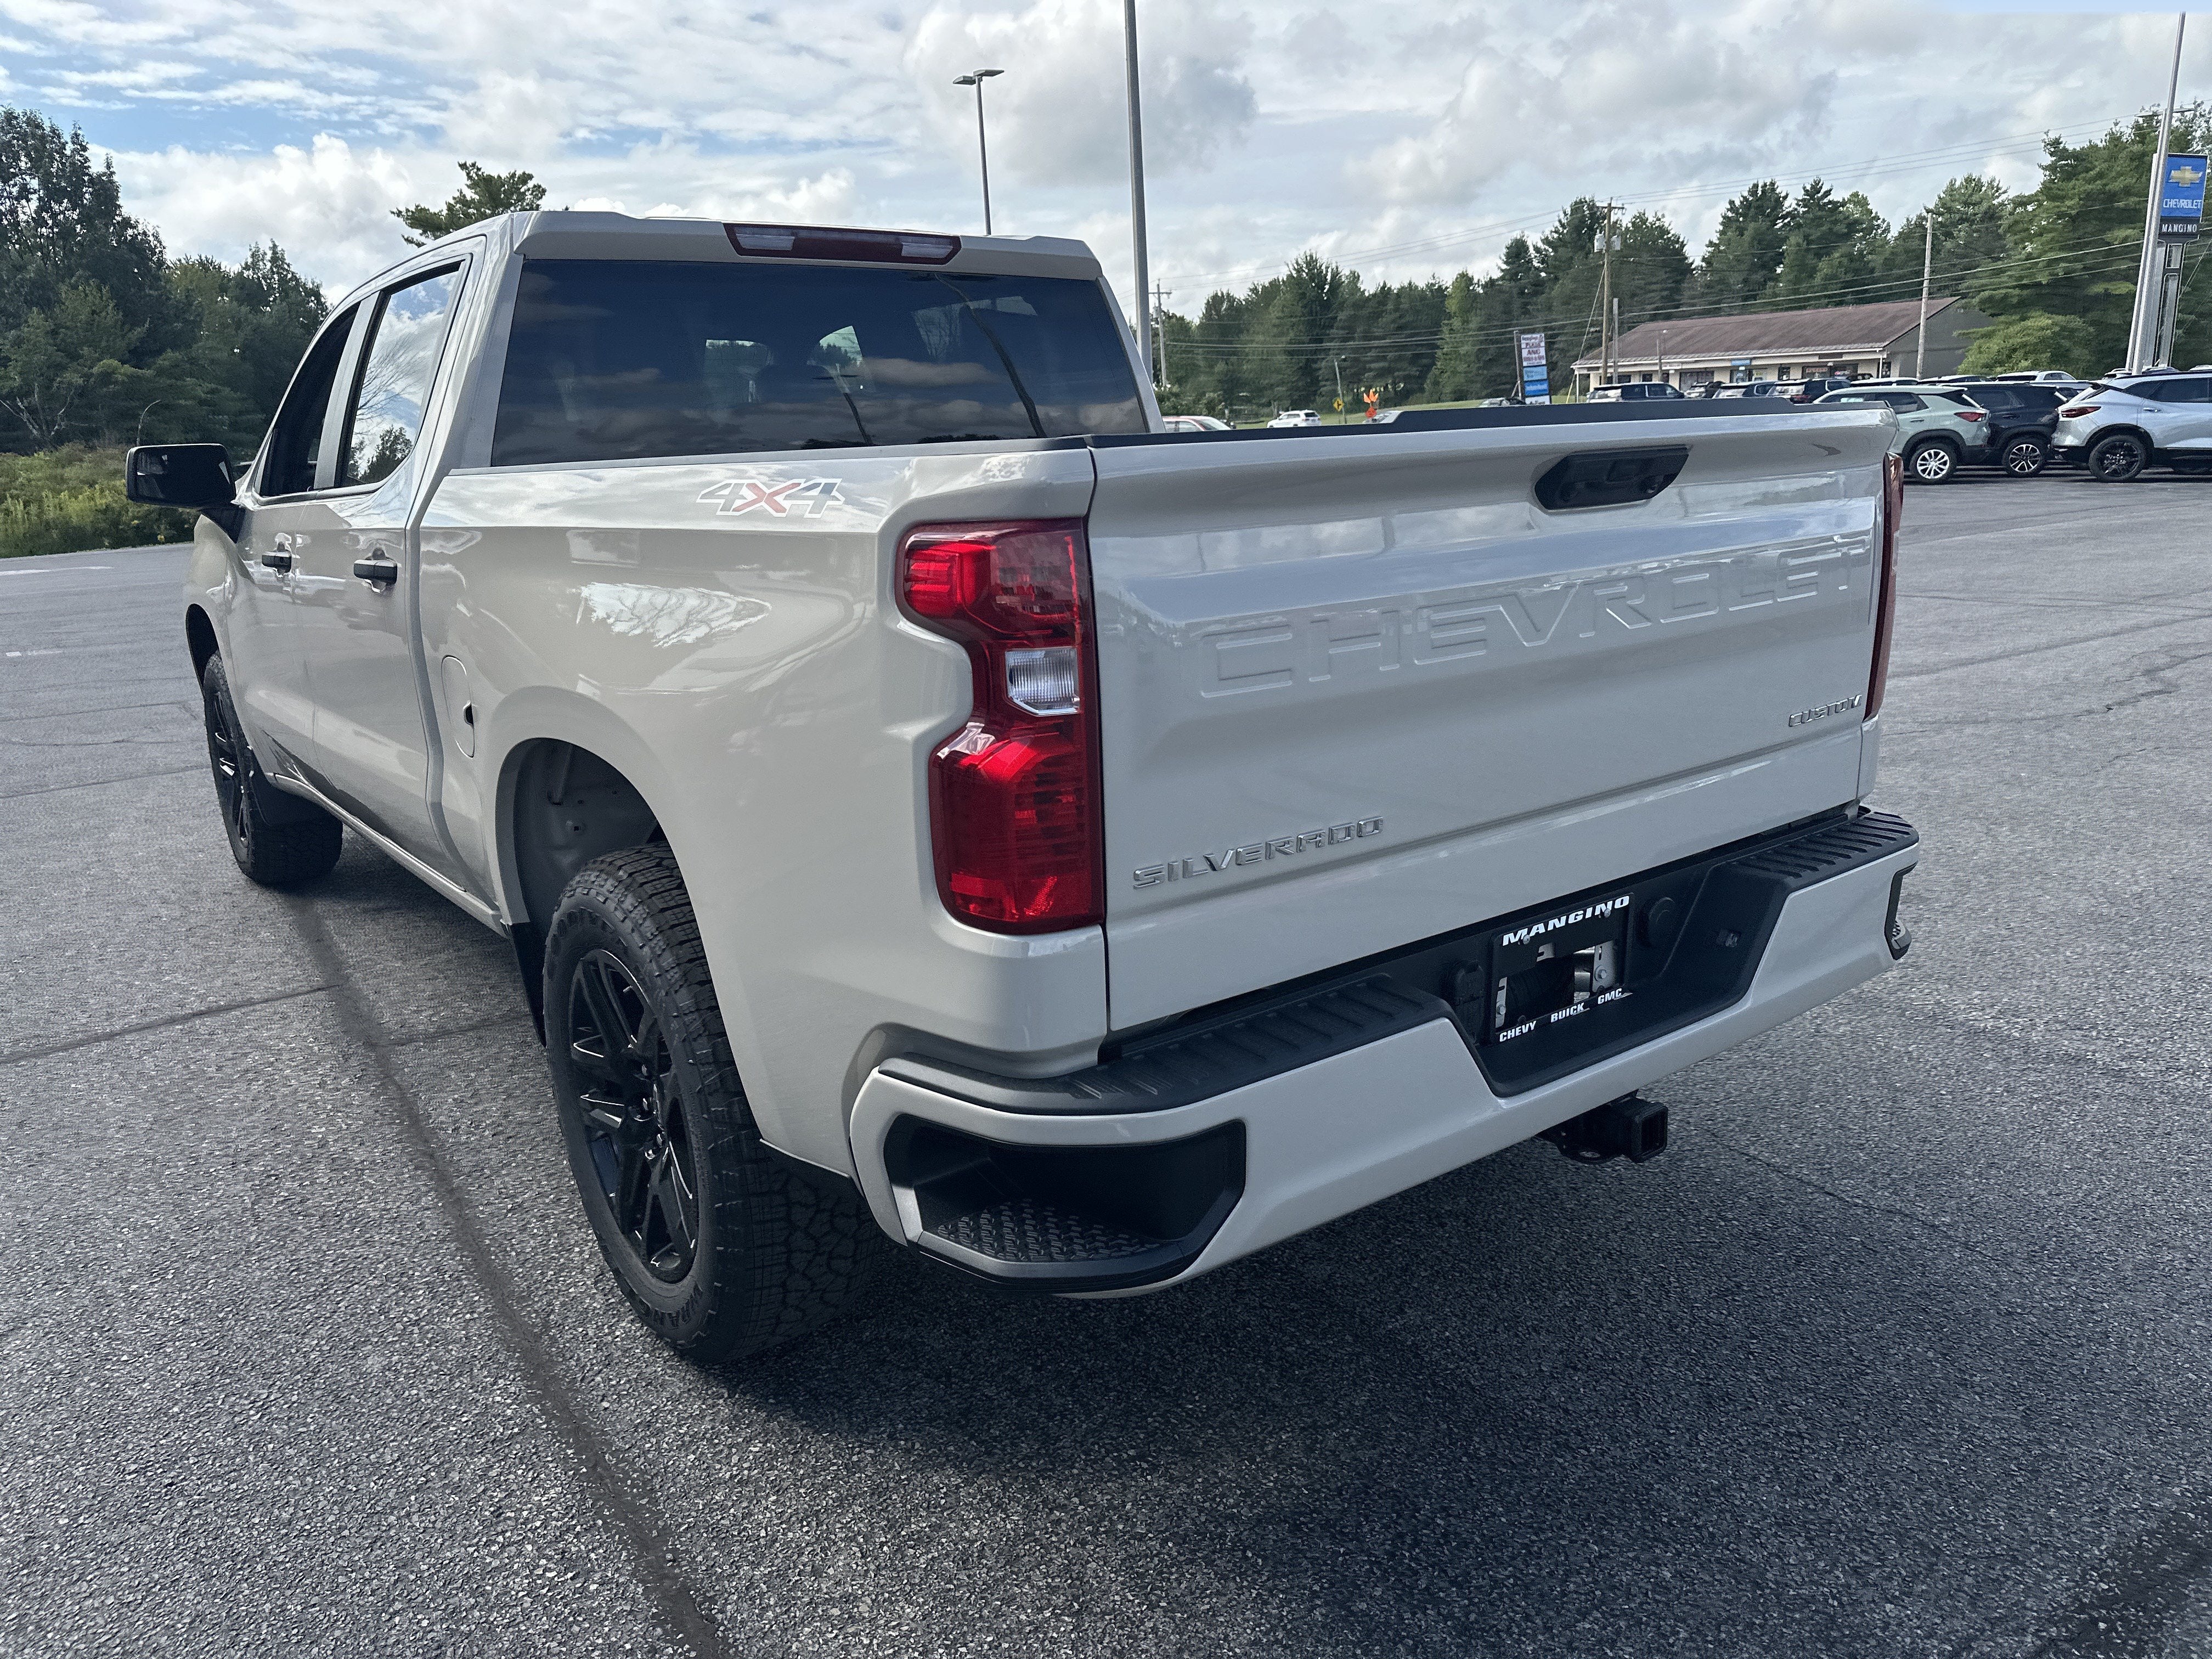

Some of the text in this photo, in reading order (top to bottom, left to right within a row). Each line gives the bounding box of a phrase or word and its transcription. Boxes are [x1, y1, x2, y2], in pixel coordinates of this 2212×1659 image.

[2162, 223, 2198, 233] MANGINO
[2163, 199, 2202, 208] CHEVROLET
[1200, 545, 1865, 698] CHEVROLET
[1788, 694, 1863, 727] CUSTOM
[1133, 815, 1384, 889] SILVERADO
[1502, 895, 1630, 946] MANGINO
[1499, 988, 1622, 1042] CHEVY BUICK GMC
